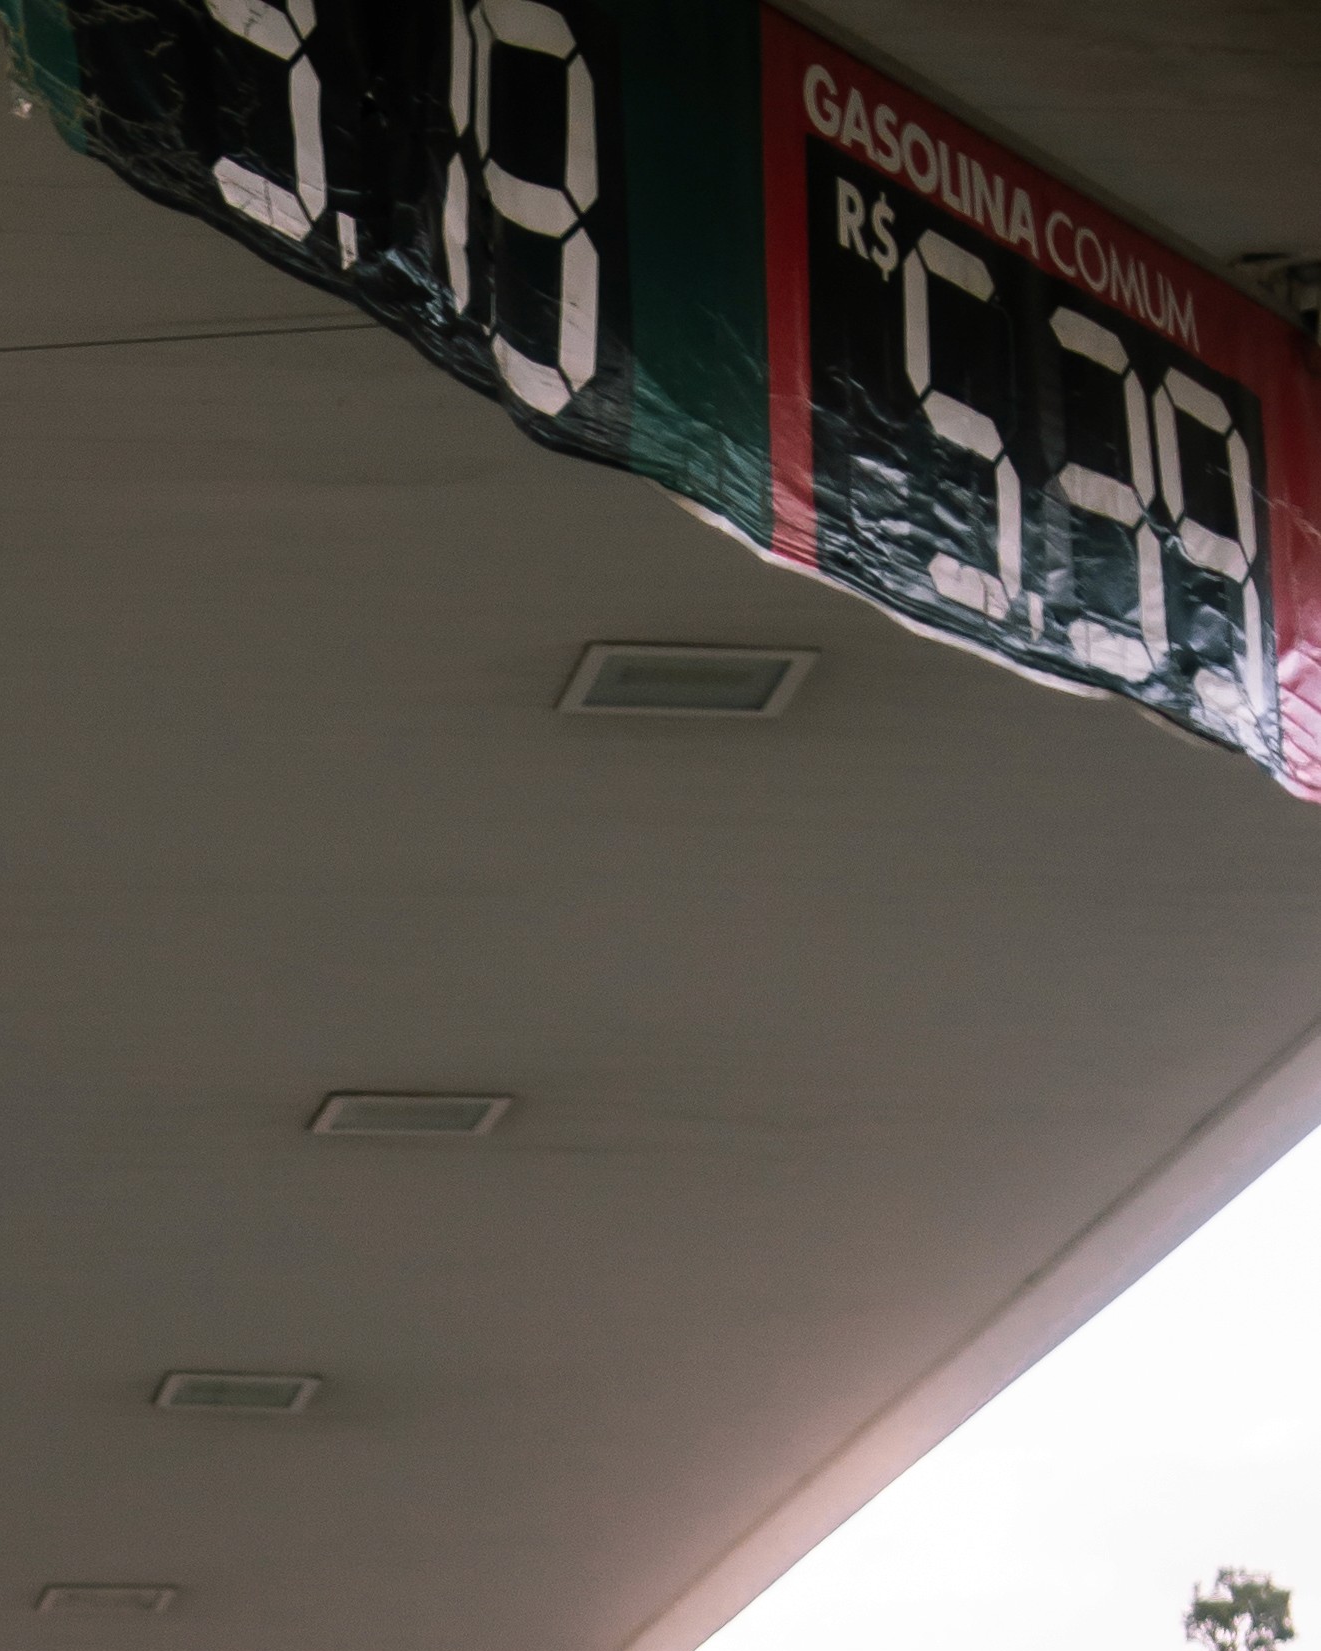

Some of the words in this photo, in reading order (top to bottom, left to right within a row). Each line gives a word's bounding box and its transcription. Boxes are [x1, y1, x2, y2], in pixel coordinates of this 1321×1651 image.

[803, 63, 1039, 259] GASOLINA
[1046, 211, 1200, 352] COMUM
[837, 179, 898, 281] R$
